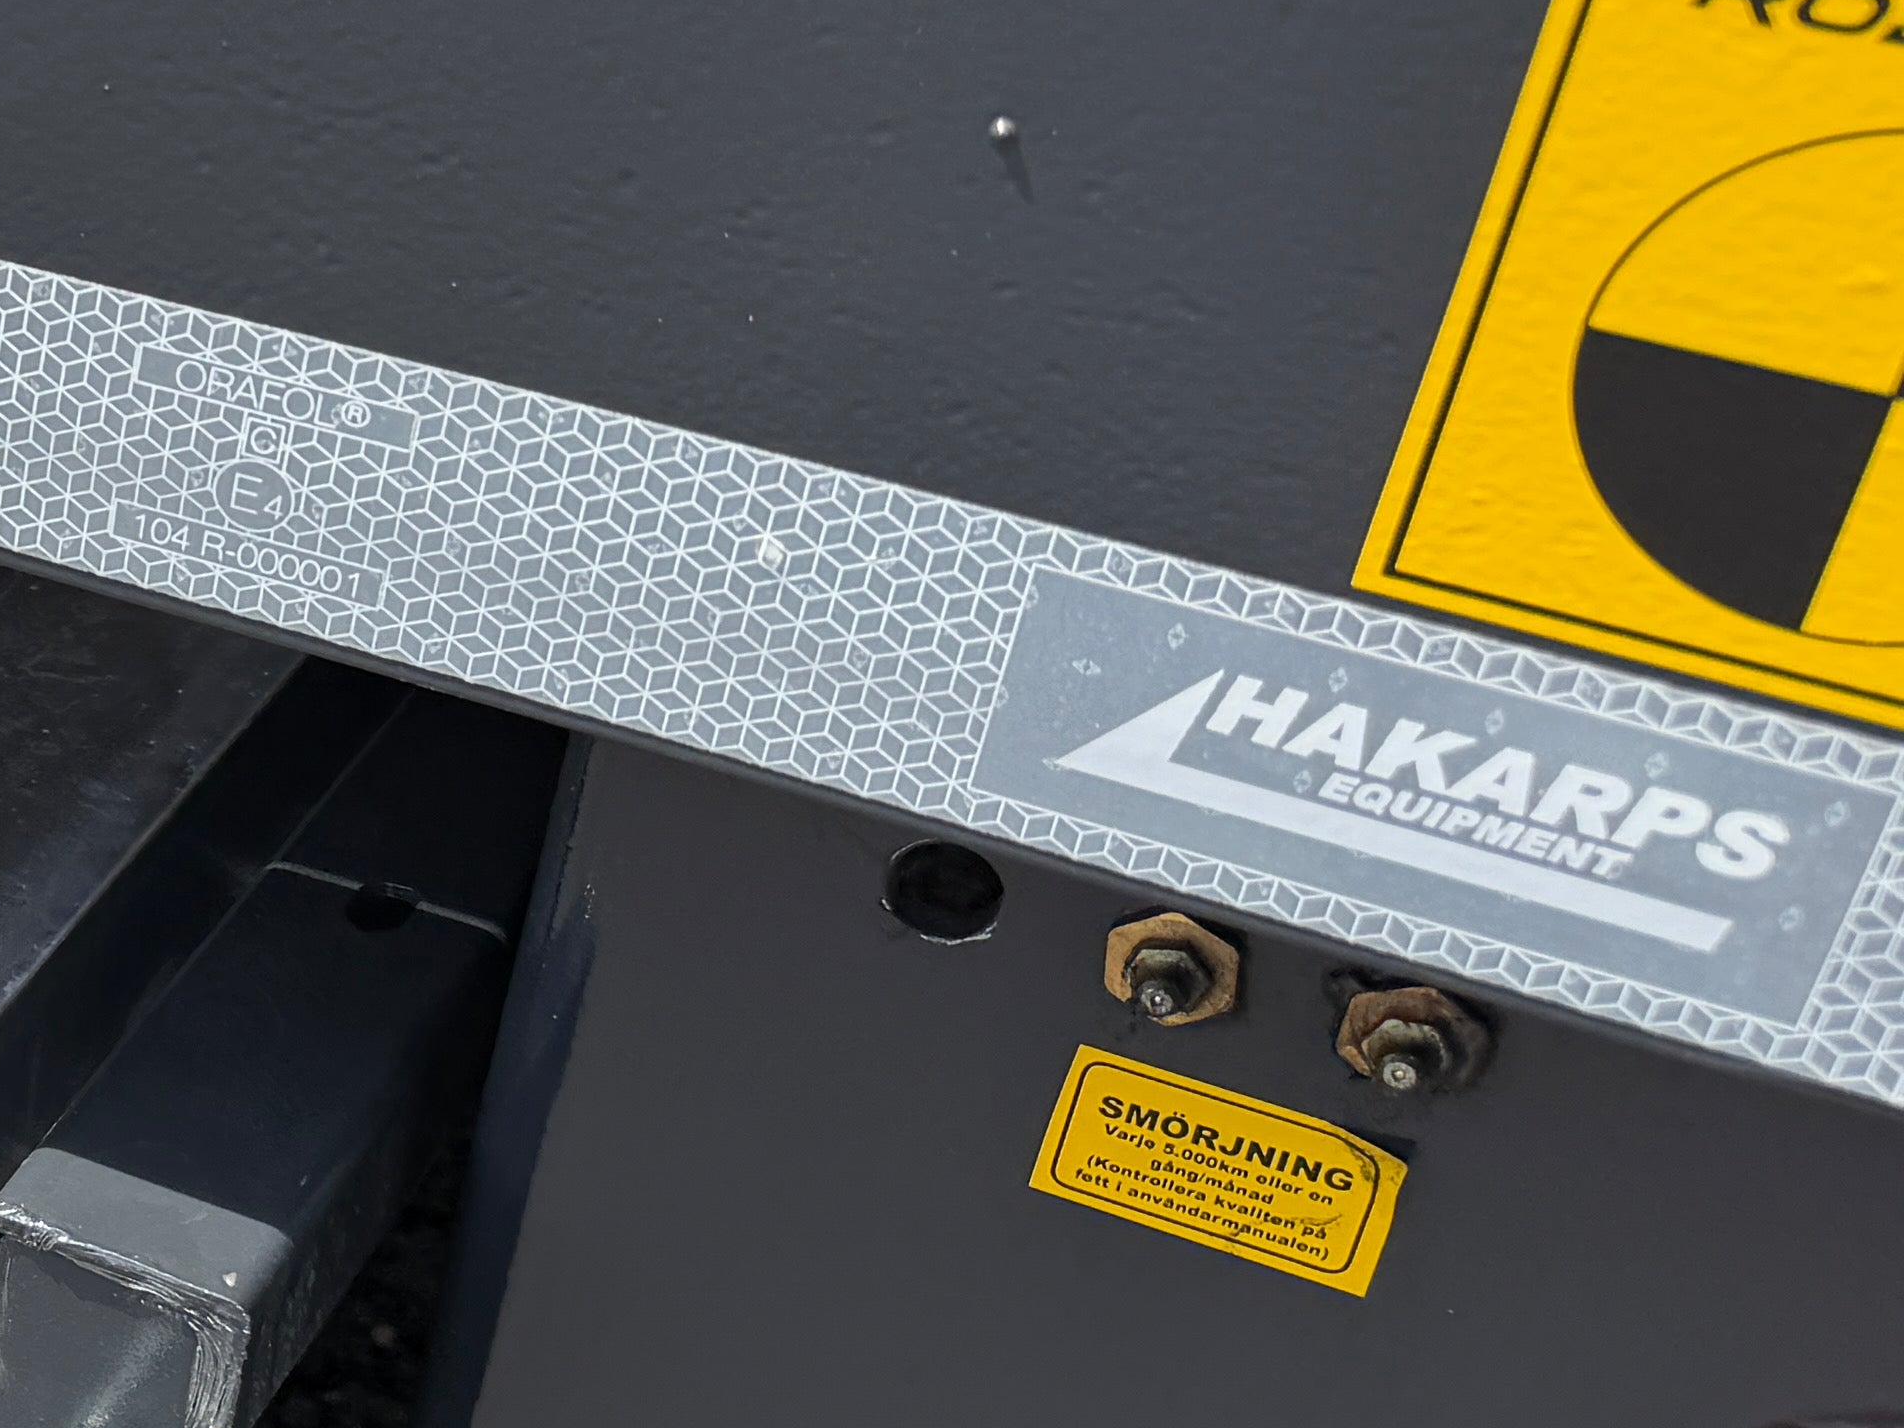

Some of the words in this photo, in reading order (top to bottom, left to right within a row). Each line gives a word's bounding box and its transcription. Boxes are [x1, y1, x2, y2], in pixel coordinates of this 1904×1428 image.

[135, 514, 190, 551] 104
[201, 530, 360, 598] R-000001
[1205, 675, 1791, 882] HAKARPS
[1318, 773, 1633, 879] EQUIPMENT
[1075, 1169, 1110, 1189] fett
[1098, 1096, 1354, 1191] SMÖRJNING
[1105, 1123, 1155, 1149] Varje
[1163, 1143, 1249, 1178] 5.000km
[1256, 1175, 1303, 1194] eller
[1309, 1191, 1333, 1205] en
[1150, 1159, 1274, 1205] gång/månad
[1087, 1155, 1207, 1202] (Kontrollera
[1301, 1226, 1327, 1239] på
